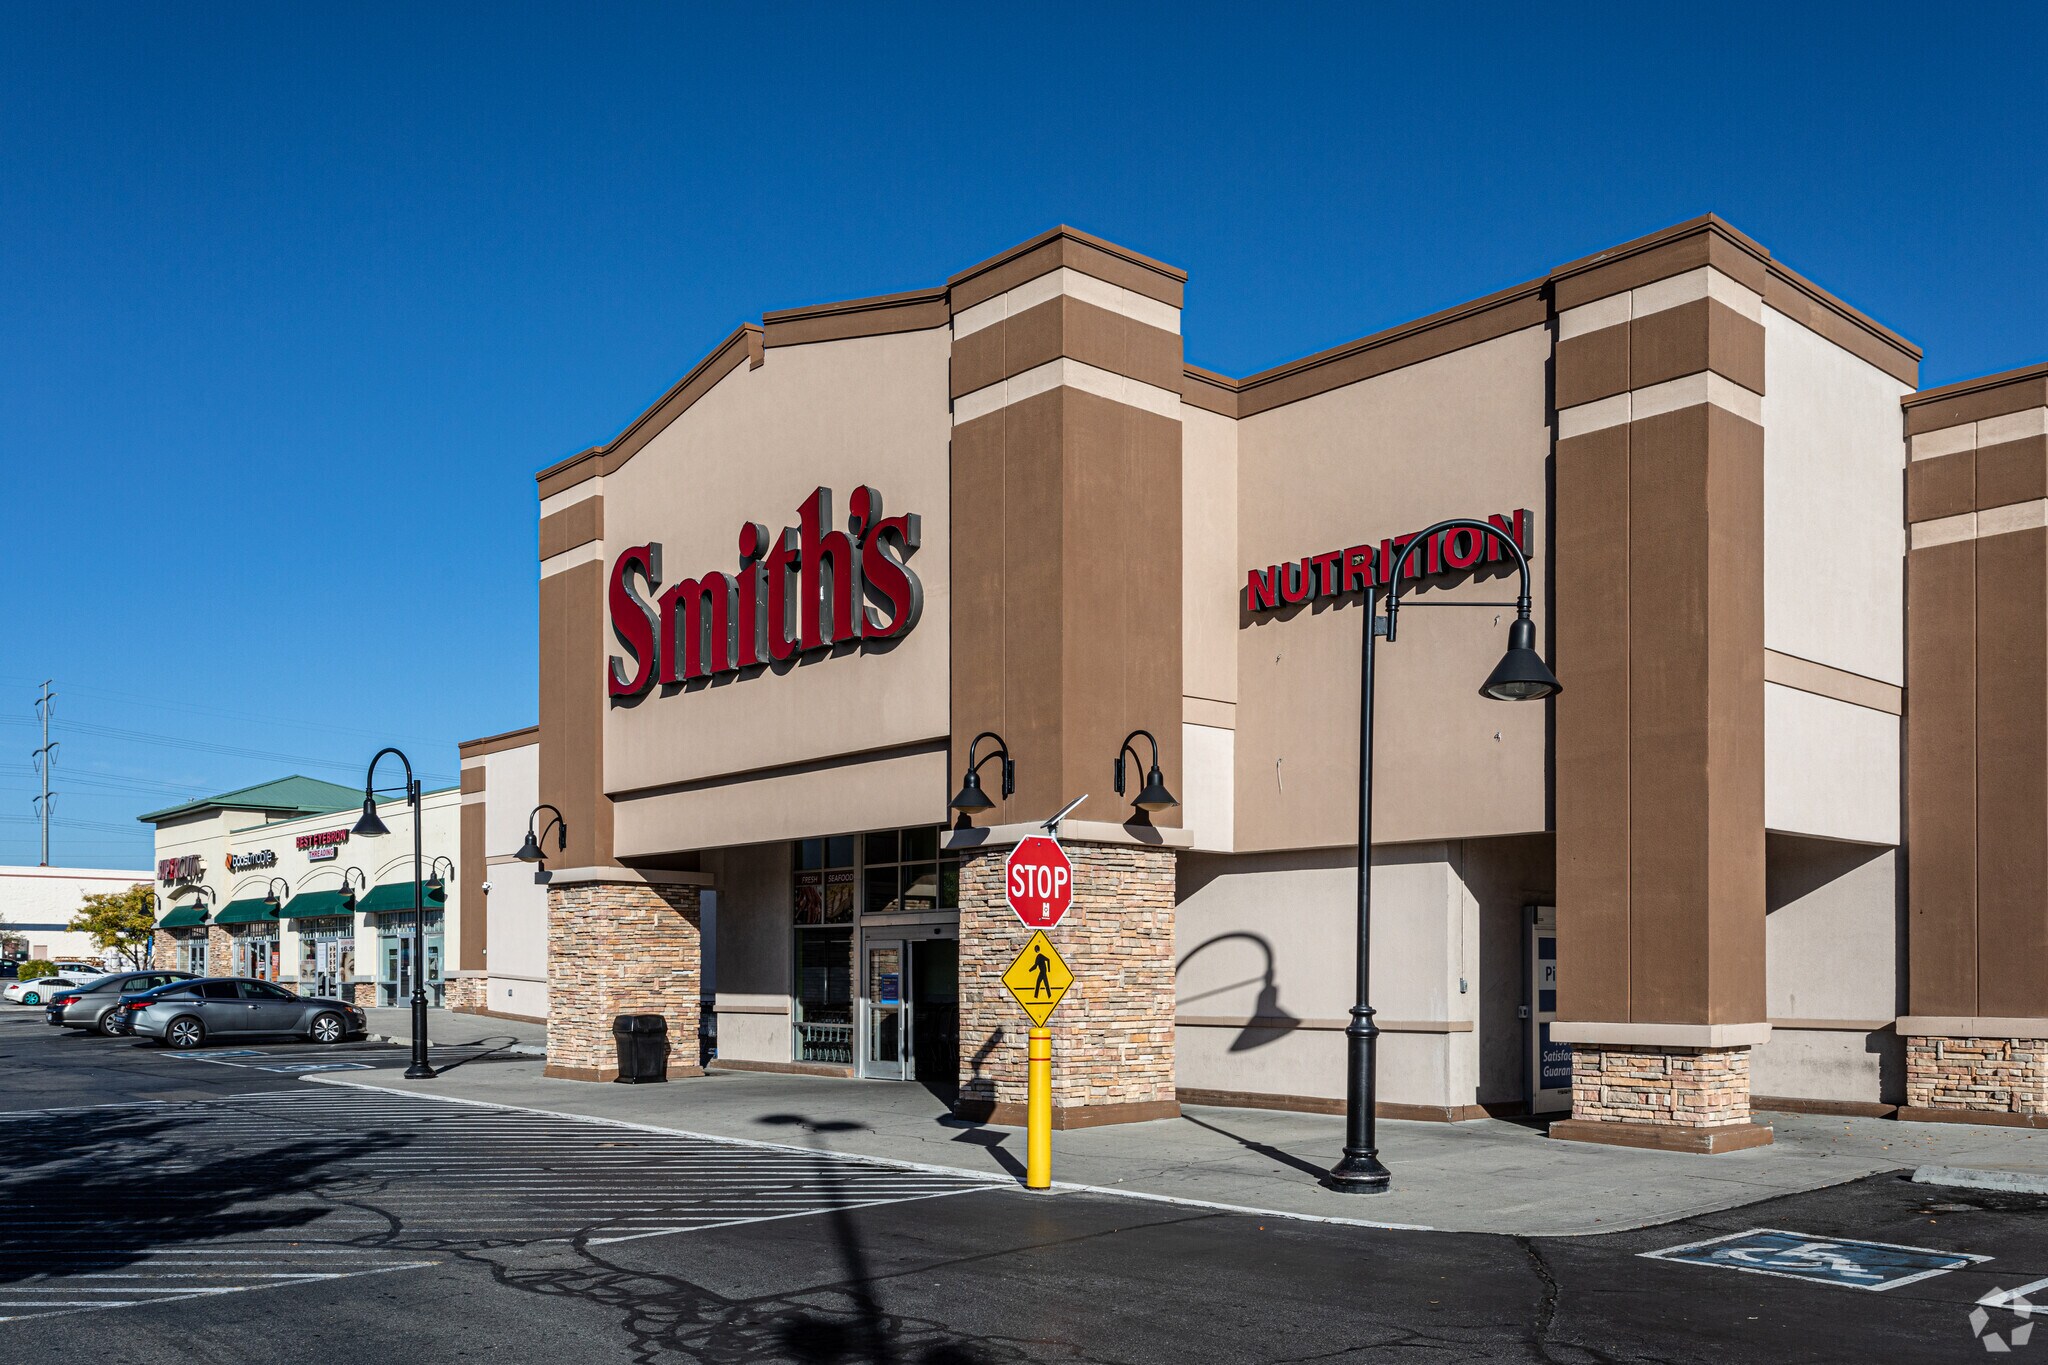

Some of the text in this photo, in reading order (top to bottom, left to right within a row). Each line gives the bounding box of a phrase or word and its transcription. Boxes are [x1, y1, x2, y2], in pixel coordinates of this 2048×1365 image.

[1248, 508, 1531, 612] NUTRITION
[609, 484, 922, 697] Smith's
[296, 829, 347, 848] BEST EYEBROW
[309, 848, 334, 858] THREADING
[157, 855, 201, 880] SUPERCUTS
[801, 873, 854, 884] FRESH SEAFOOD
[1011, 863, 1069, 899] STOP
[1543, 1065, 1572, 1077] Guaran
